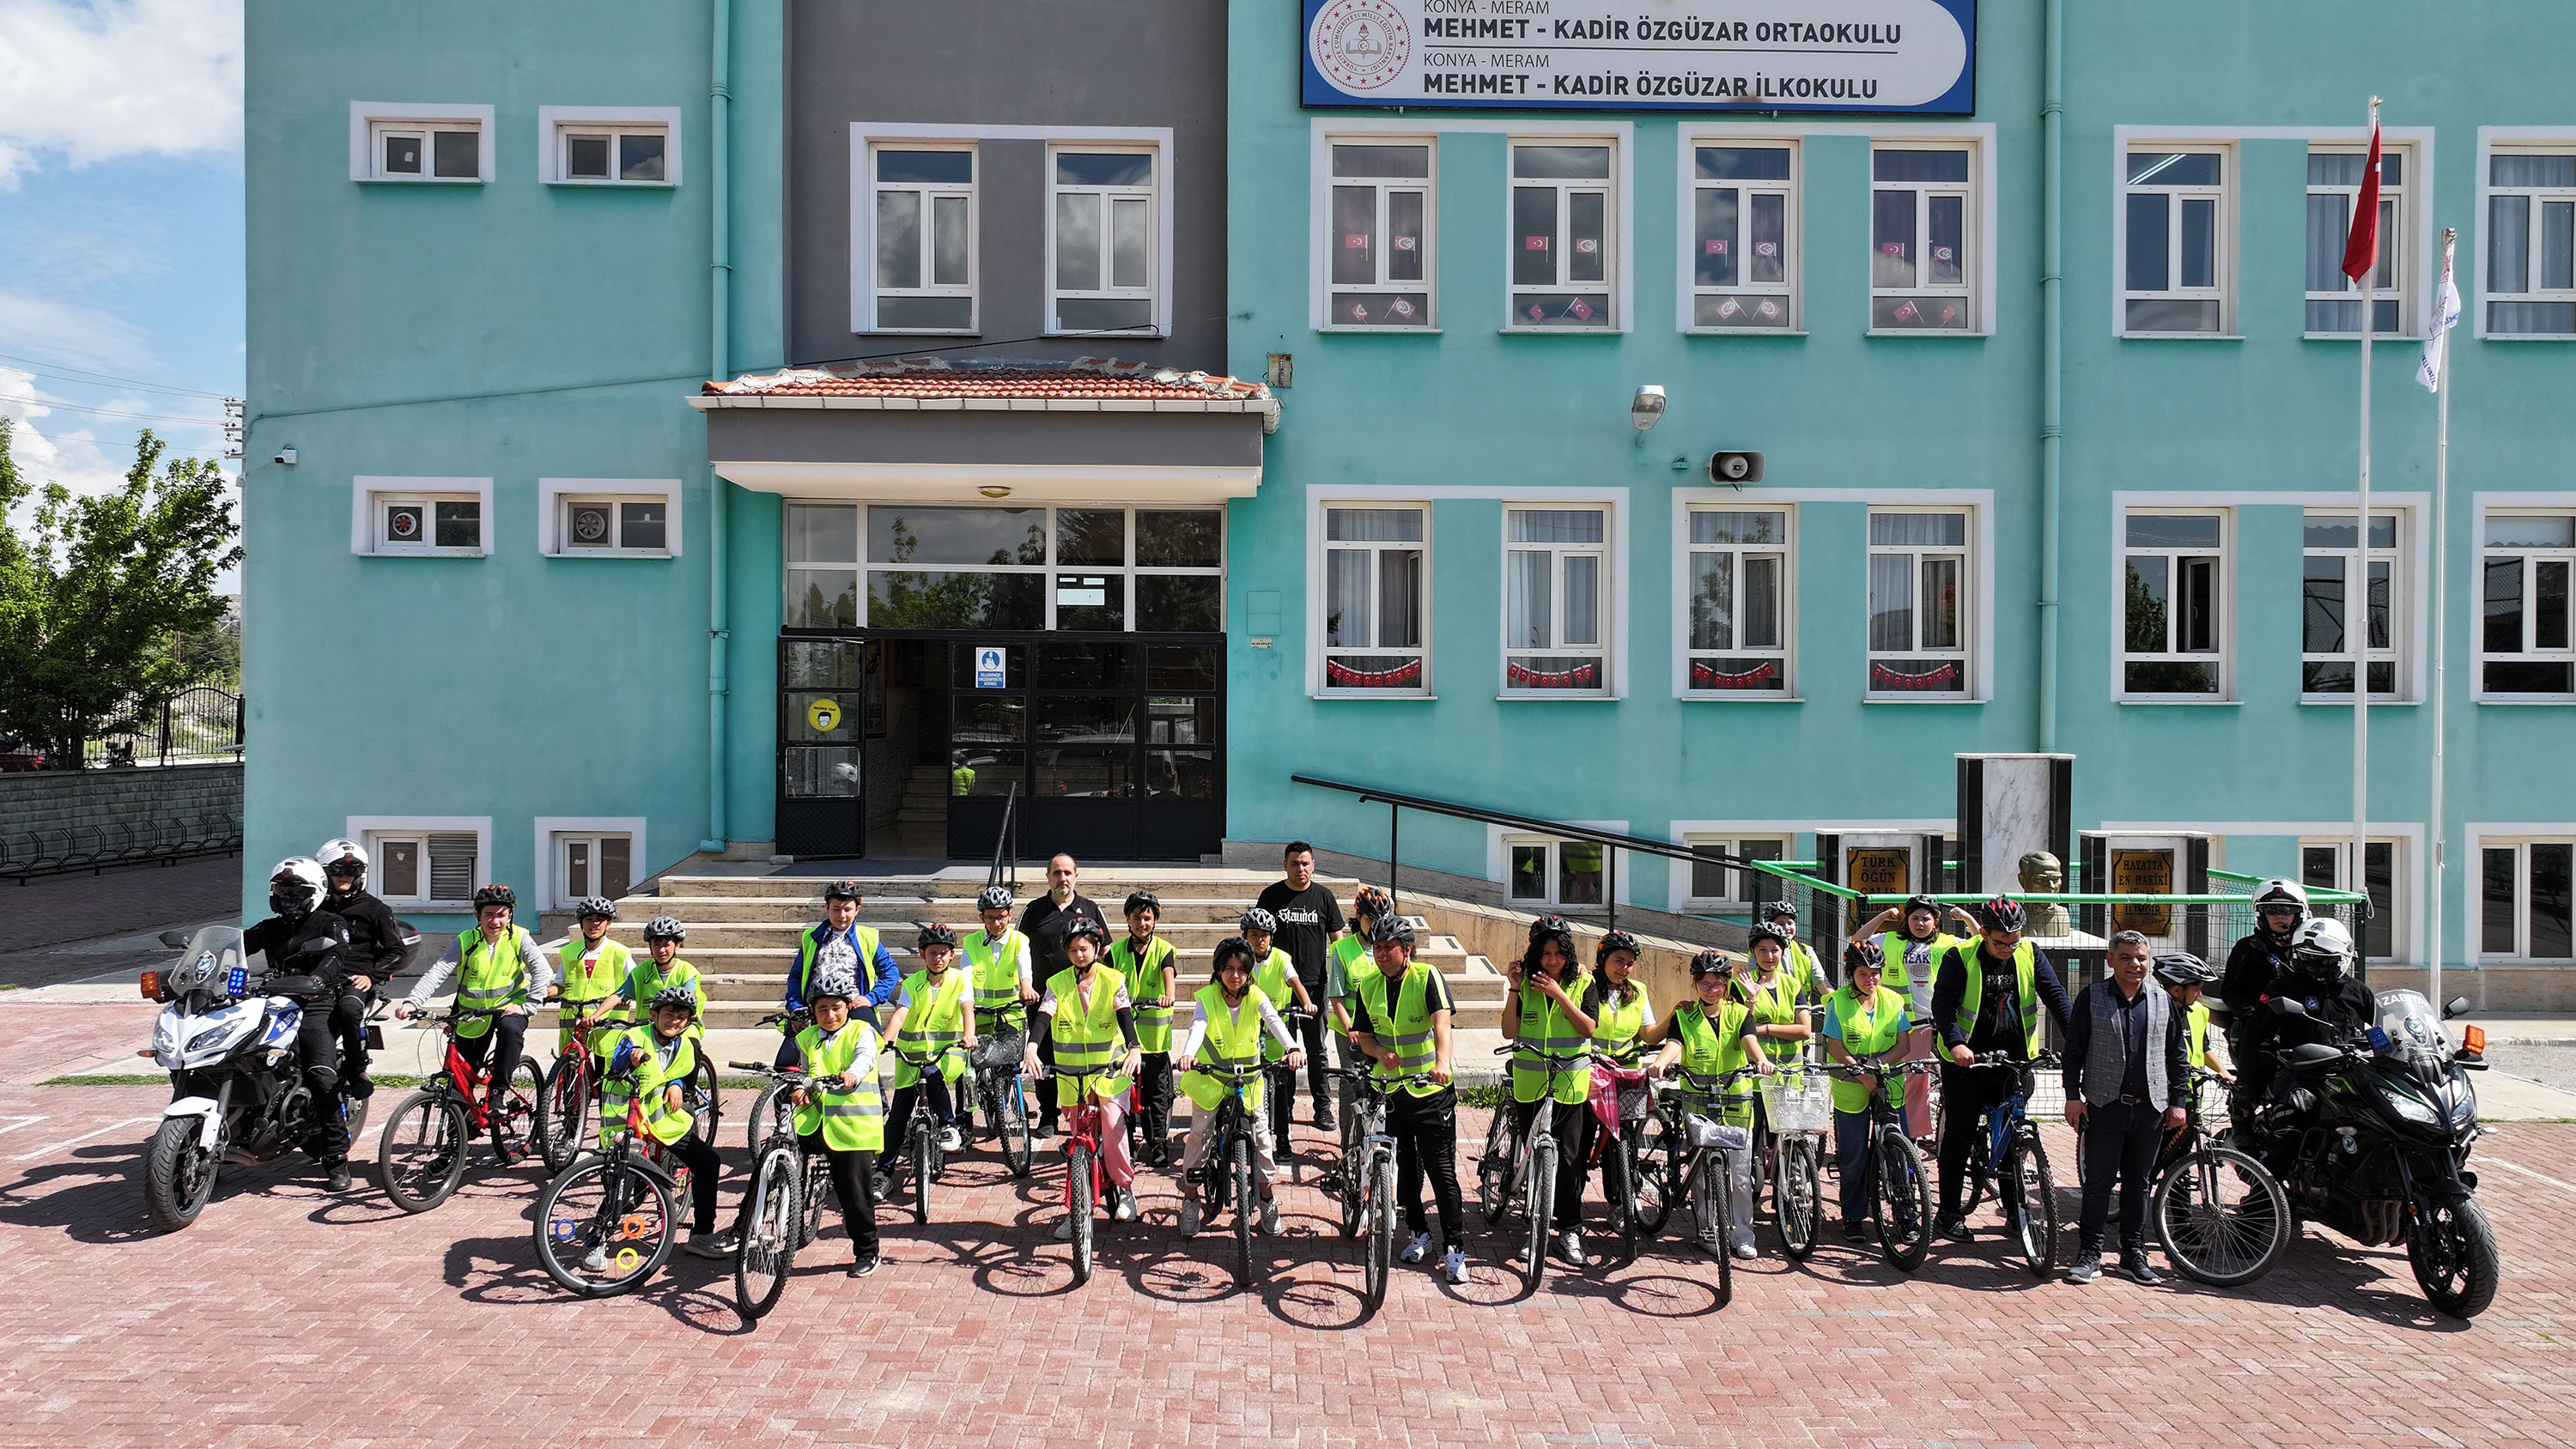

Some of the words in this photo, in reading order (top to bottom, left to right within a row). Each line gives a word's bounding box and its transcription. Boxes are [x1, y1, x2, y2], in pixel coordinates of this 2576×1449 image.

[1424, 0, 1477, 14] KONYA
[1491, 0, 1550, 15] MERAM
[1424, 17, 1530, 39] MEHMET
[1554, 15, 1630, 40] KADİR
[1636, 15, 1748, 41] ÖZGÜZAR
[1755, 22, 1901, 44] ORTAOKULU
[1424, 52, 1477, 67] KONYA
[1491, 54, 1550, 68] MERAM
[1424, 73, 1530, 94] MEHMET
[1554, 70, 1629, 95] KADİR
[1636, 70, 1748, 97] ÖZGÜZAR
[1756, 72, 1877, 99] İLKOKULU
[1861, 854, 1896, 867] TÜRK
[2123, 860, 2164, 870] HAYATTA
[1861, 869, 1896, 882] ÖĞÜN
[2118, 875, 2130, 885] EN
[2136, 872, 2168, 885] HAKİKİ
